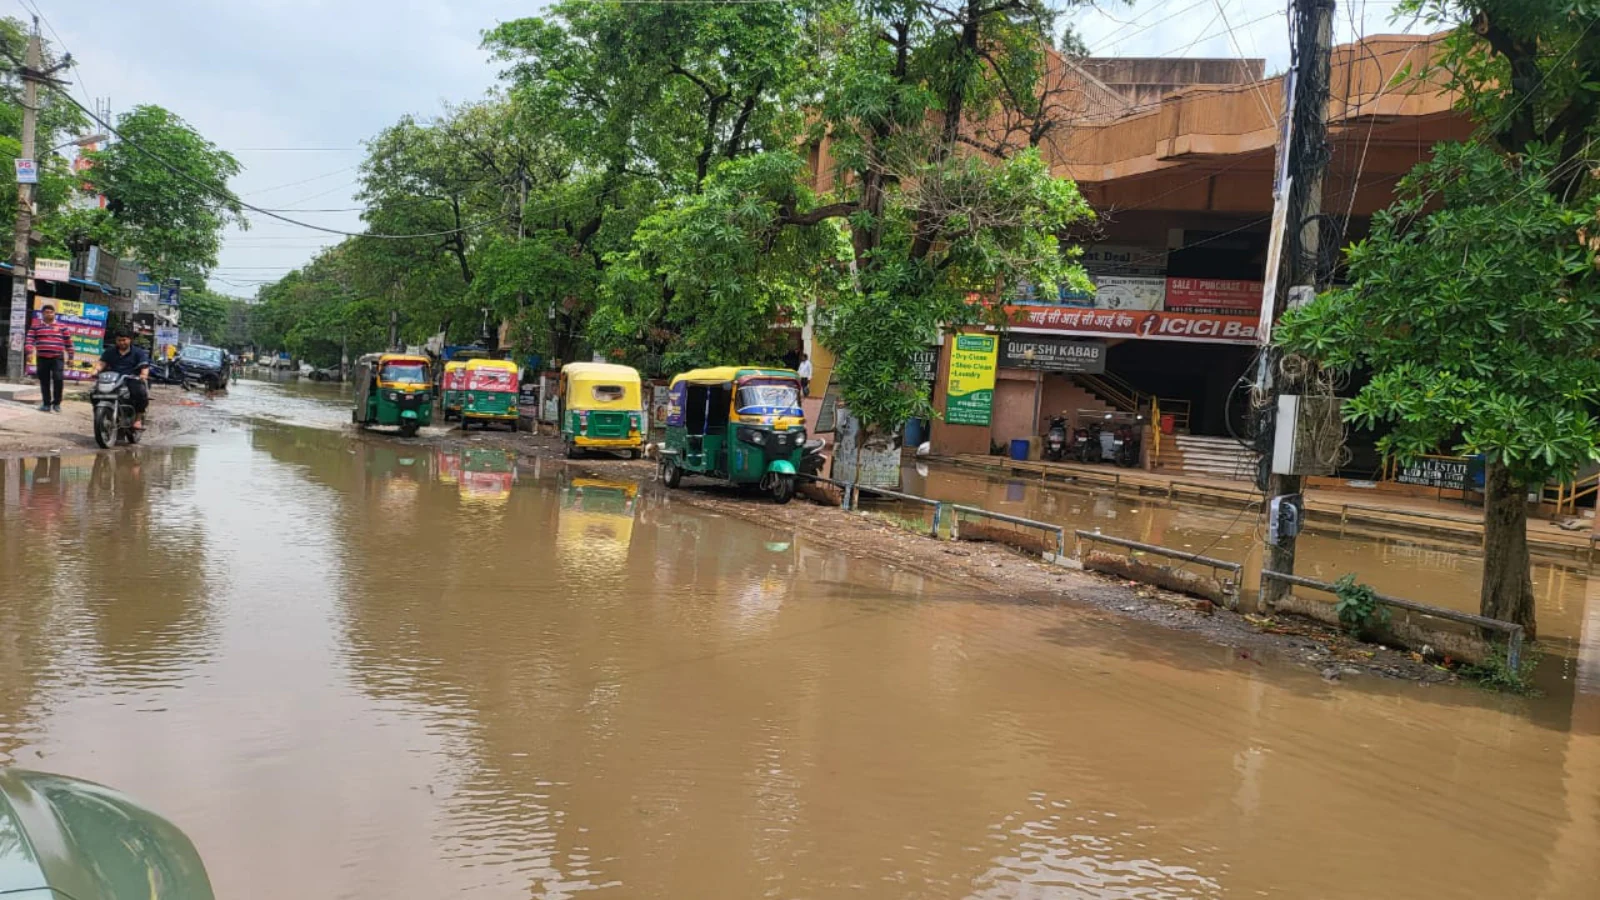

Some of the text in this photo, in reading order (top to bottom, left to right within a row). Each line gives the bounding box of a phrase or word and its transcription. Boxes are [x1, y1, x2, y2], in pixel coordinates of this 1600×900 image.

[1172, 279, 1190, 290] SALE
[1199, 281, 1241, 292] PURCHASE
[1048, 309, 1061, 324] सी
[1061, 310, 1081, 327] आई
[1081, 310, 1095, 326] सी
[1095, 311, 1115, 329] आई
[1159, 318, 1221, 336] ICICI
[1222, 321, 1260, 338] Ba
[955, 353, 967, 361] Dry
[1060, 345, 1100, 359] KABAB
[973, 363, 992, 371] Clean
[954, 369, 981, 379] Laundry
[1434, 461, 1468, 475] ESTATE
